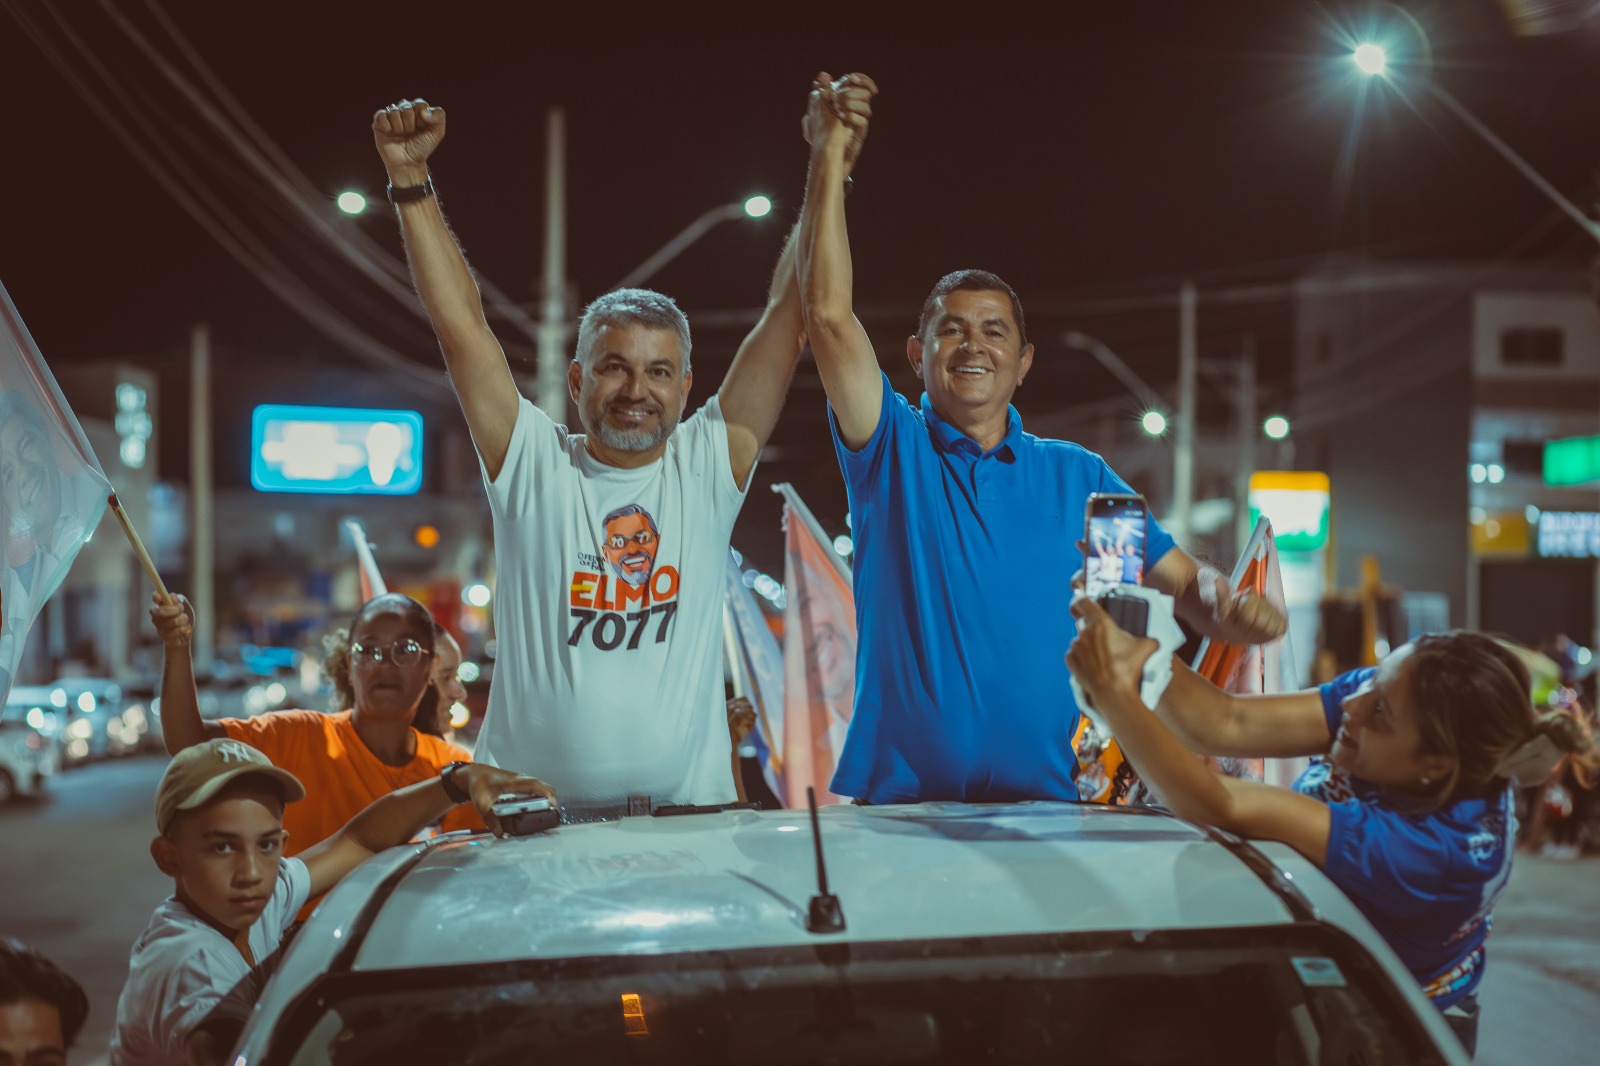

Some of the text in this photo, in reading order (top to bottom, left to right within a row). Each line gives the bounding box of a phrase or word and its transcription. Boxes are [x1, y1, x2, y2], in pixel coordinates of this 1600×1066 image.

[610, 535, 625, 548] 70
[570, 565, 680, 612] ELMO
[567, 601, 677, 651] 7077
[218, 742, 252, 763] NY
